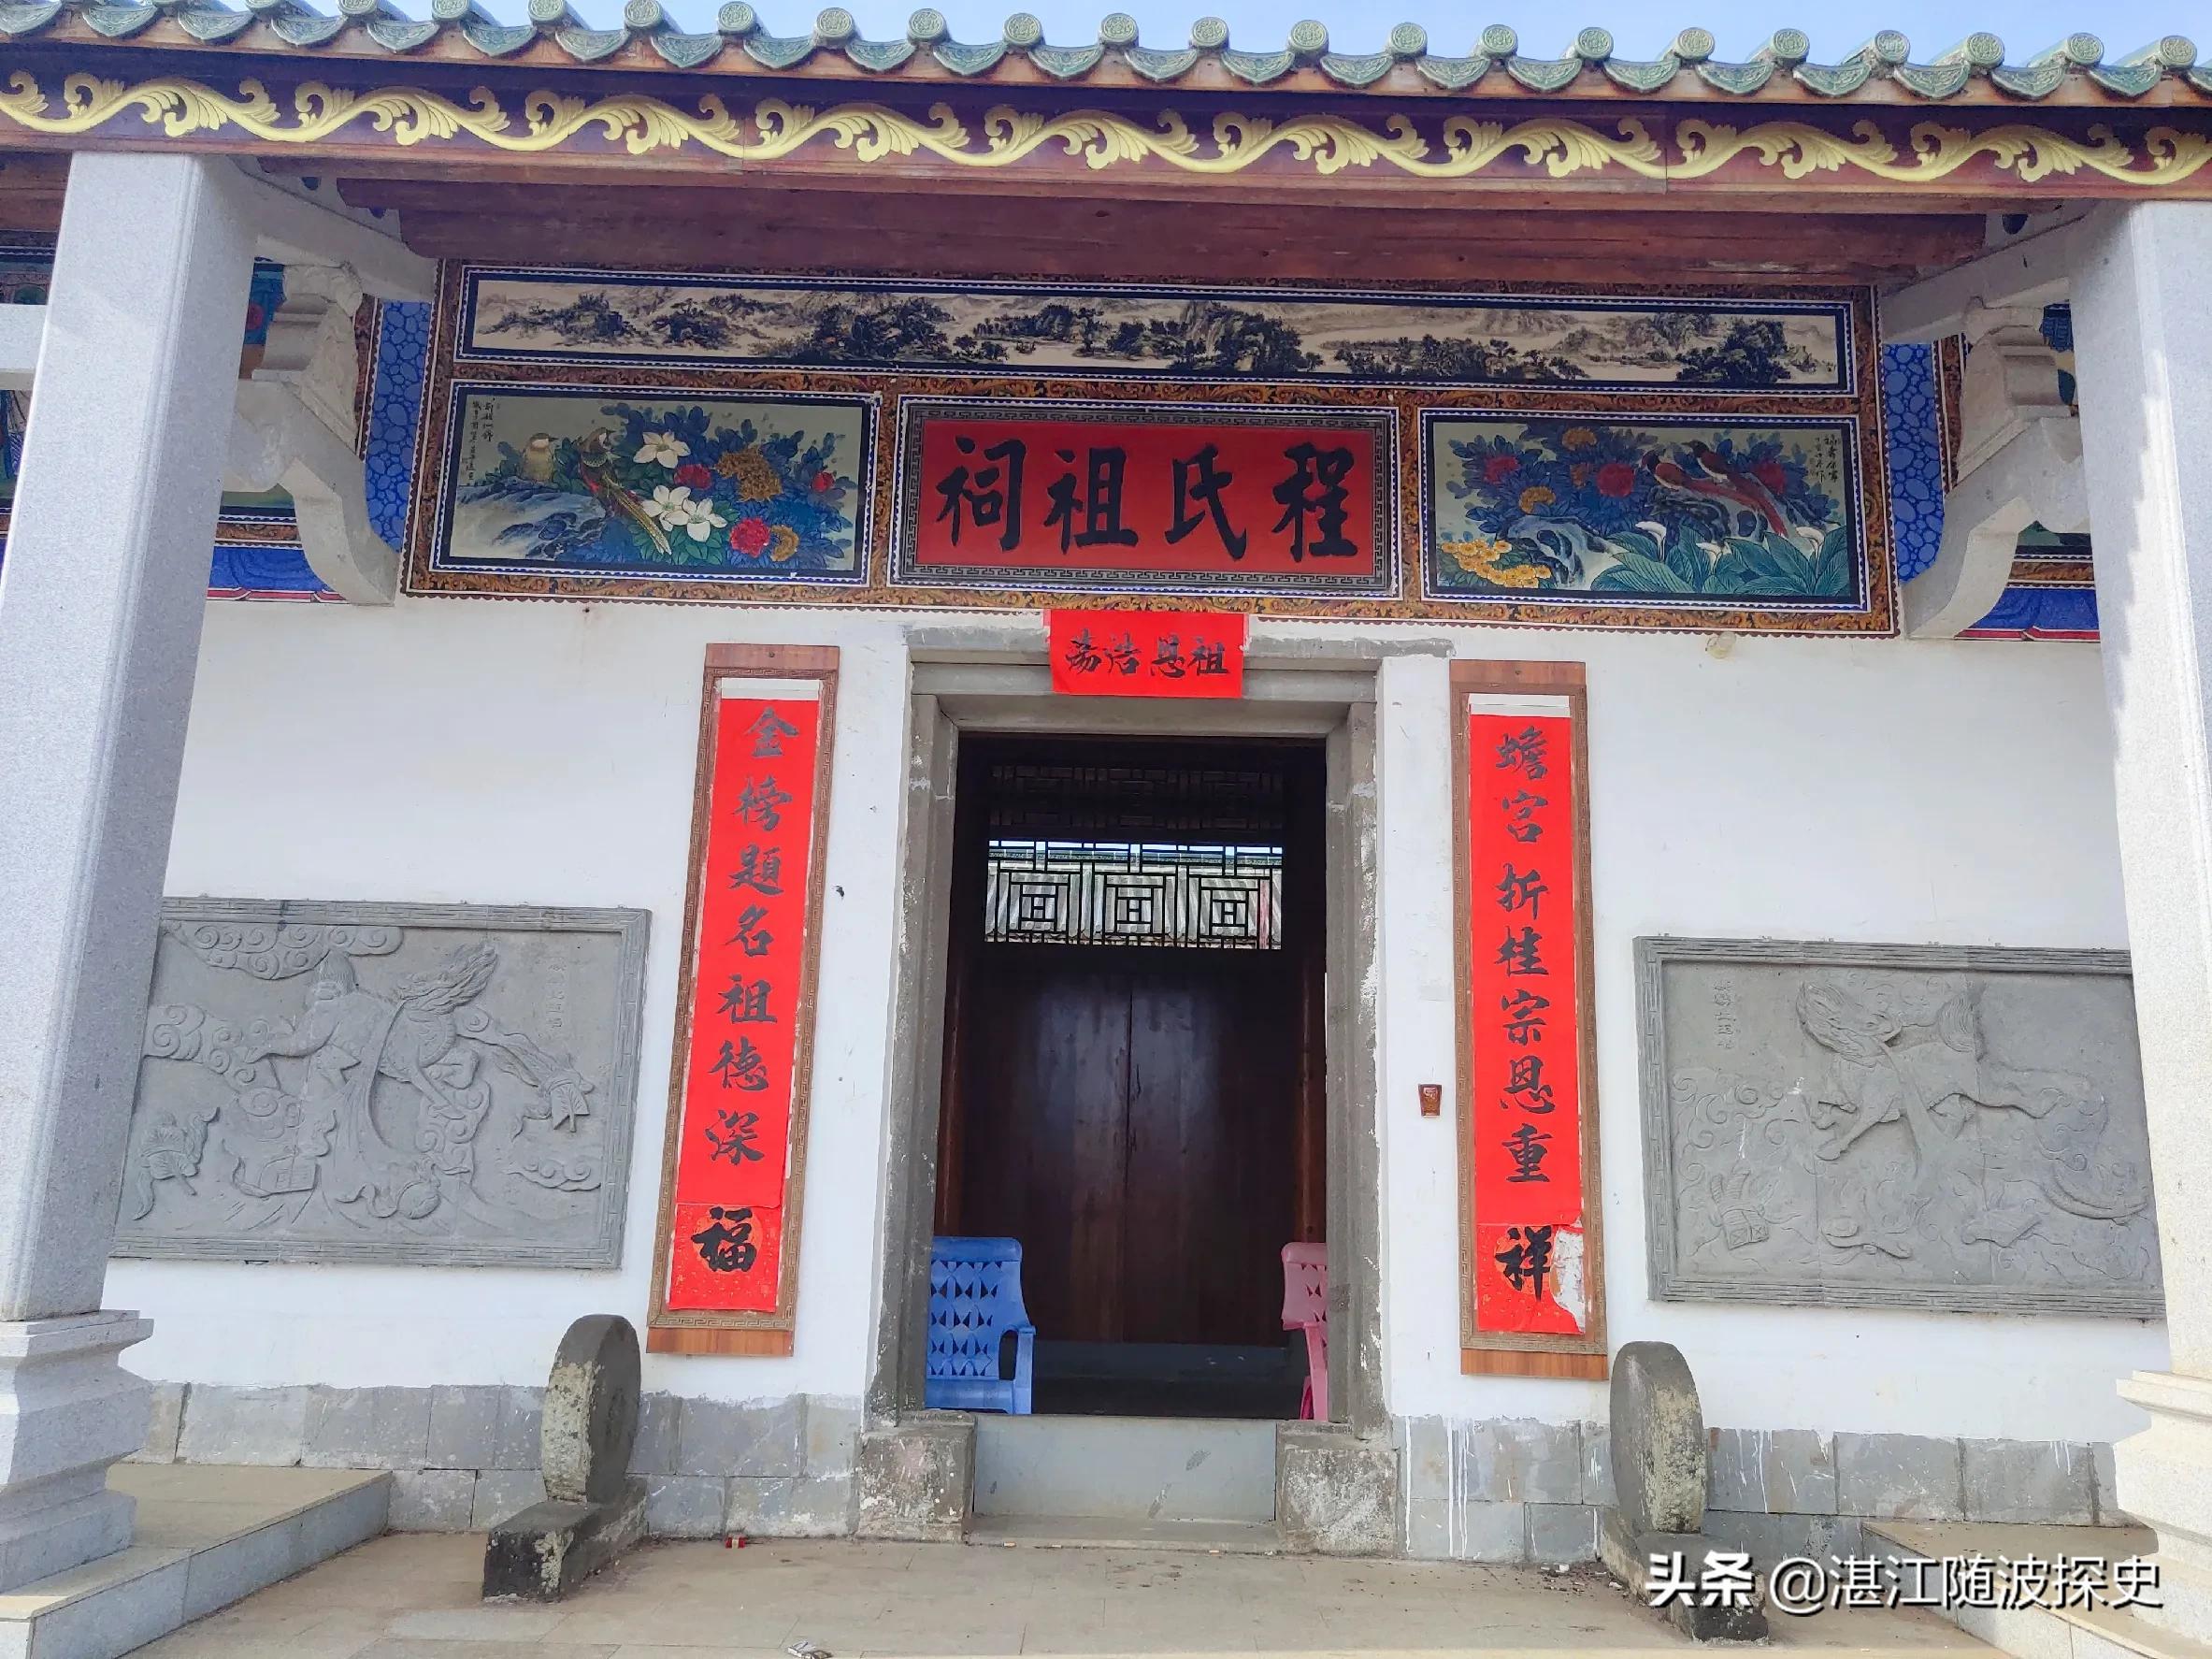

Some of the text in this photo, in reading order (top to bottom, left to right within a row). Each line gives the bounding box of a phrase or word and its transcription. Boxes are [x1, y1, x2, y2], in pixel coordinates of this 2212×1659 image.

[936, 436, 1357, 561] 程氏祖祠
[691, 1206, 756, 1273] 福
[1494, 1225, 1553, 1303] 祥
